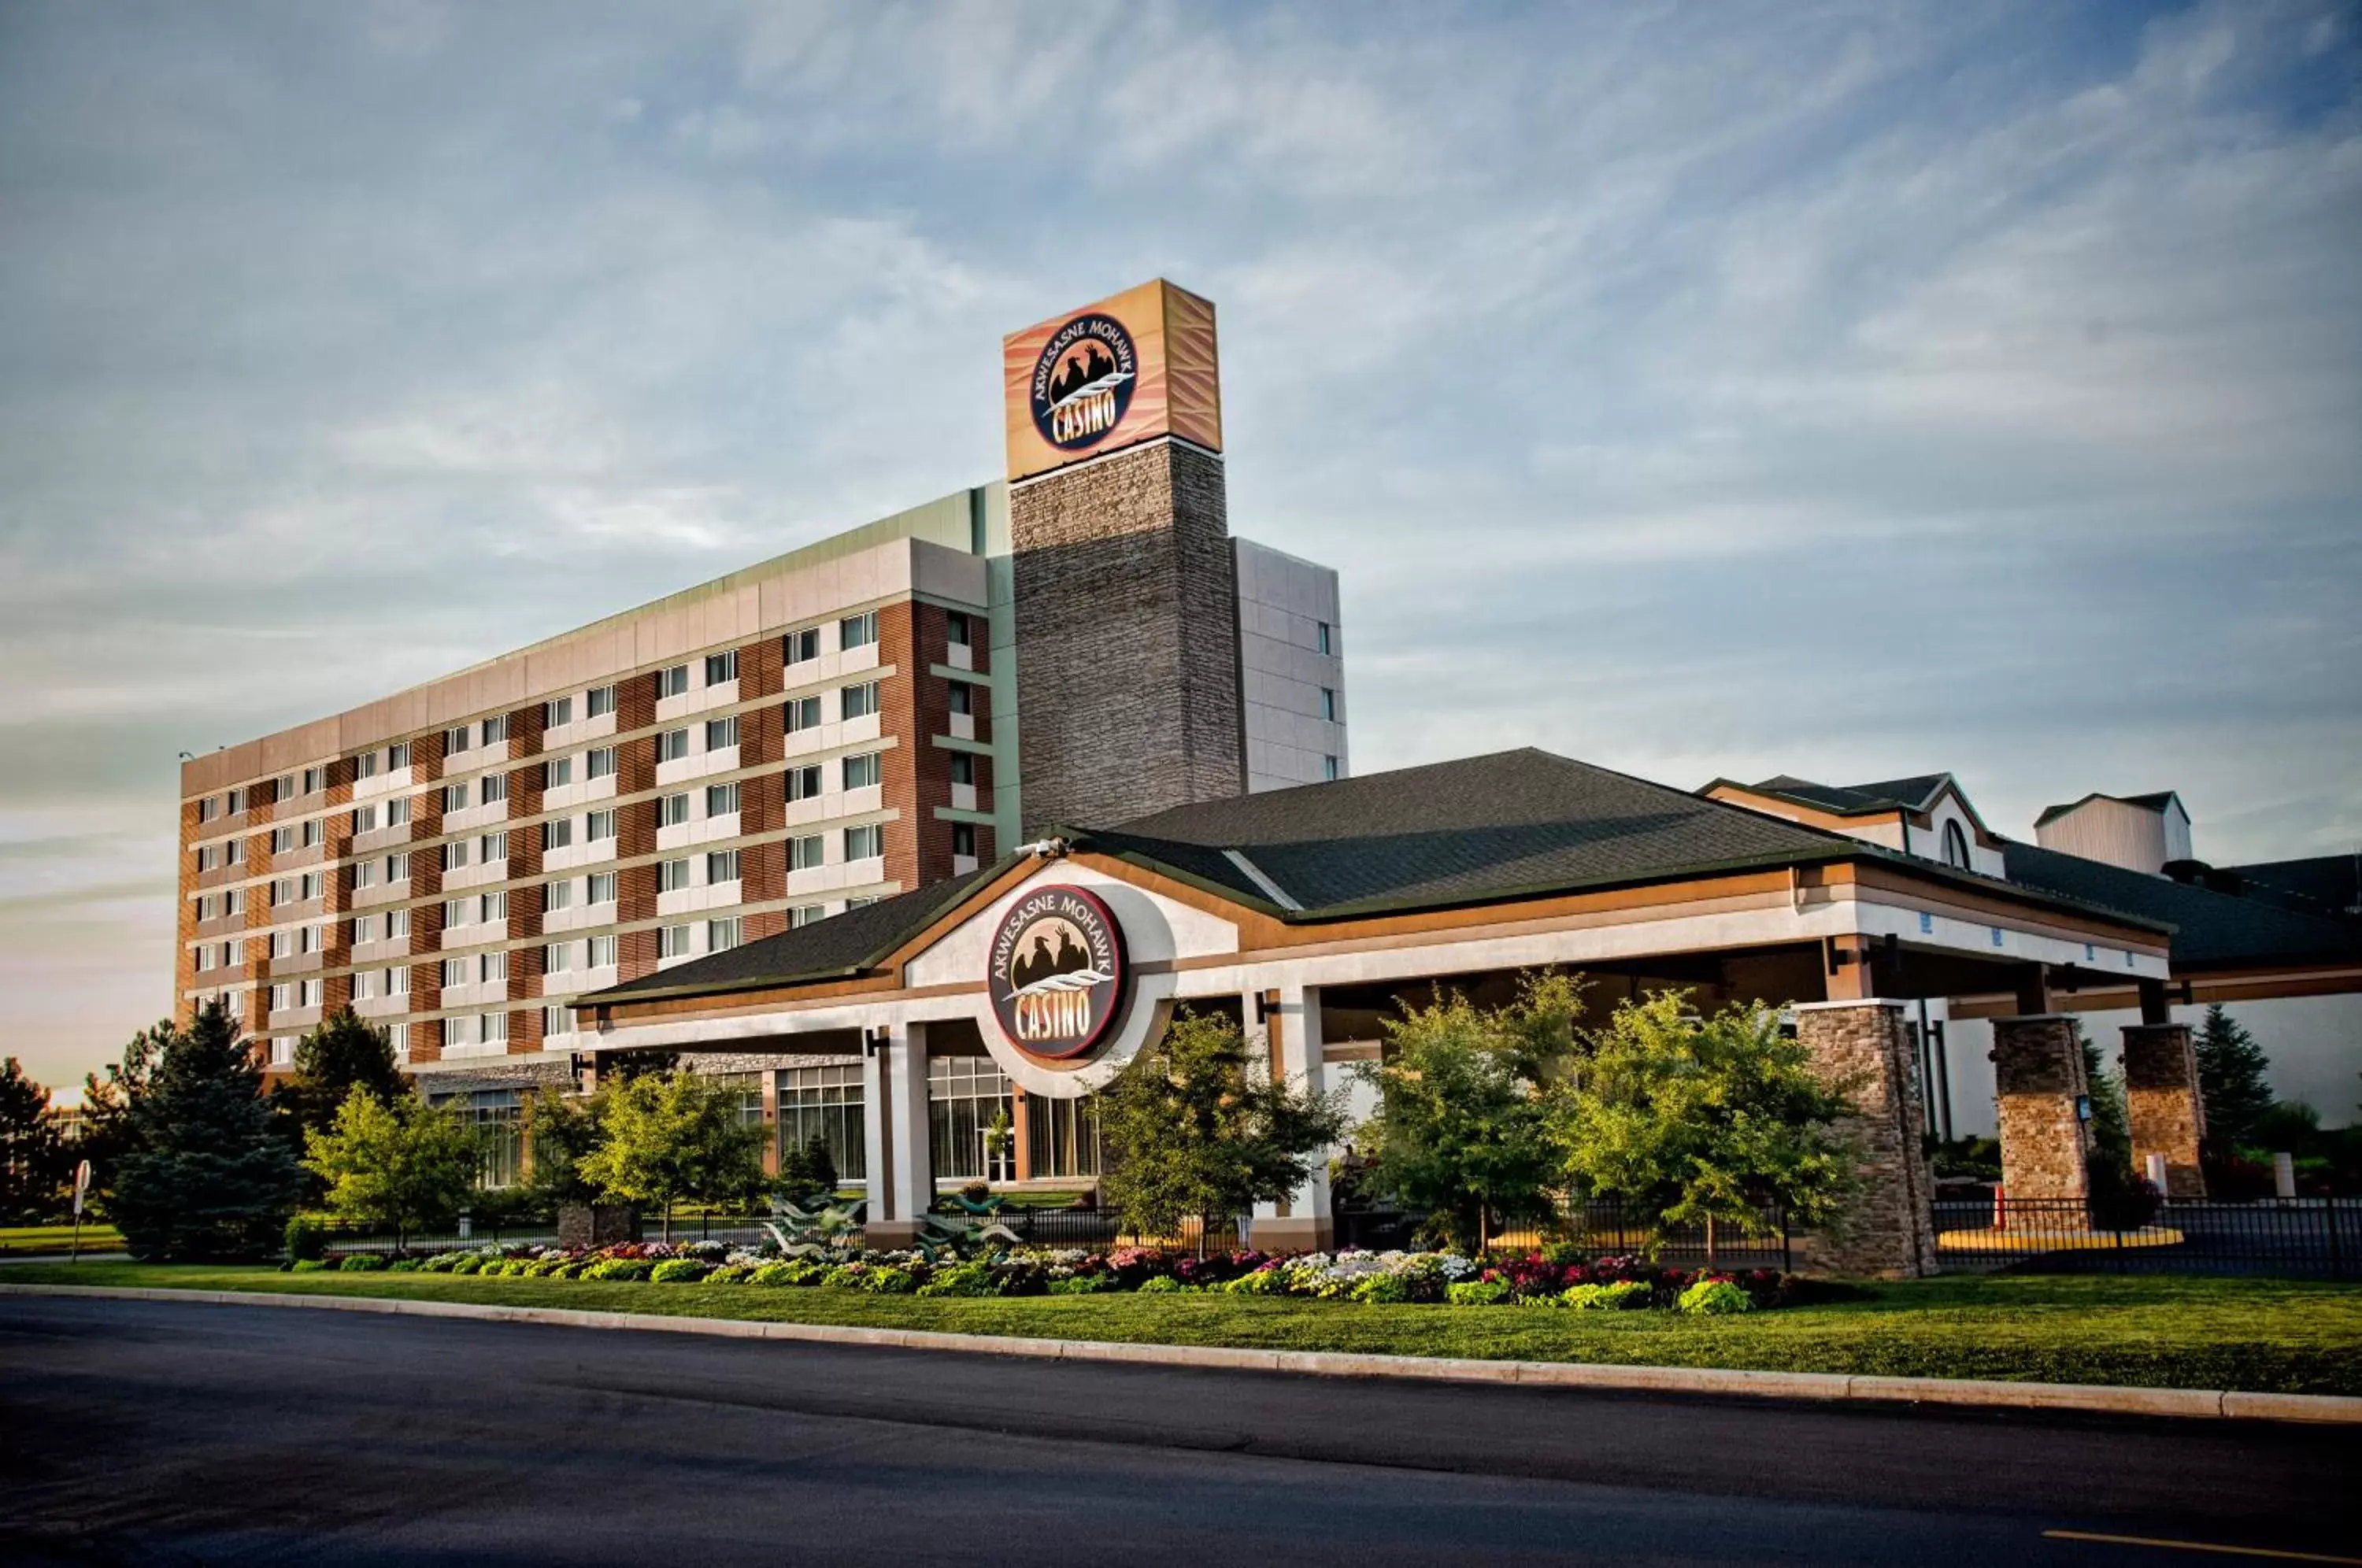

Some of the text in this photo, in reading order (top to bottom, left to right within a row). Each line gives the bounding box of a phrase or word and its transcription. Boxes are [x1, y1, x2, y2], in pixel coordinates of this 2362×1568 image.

[1035, 320, 1133, 400] AKWESASNE MOHAWK
[1053, 391, 1116, 442] CASINO
[994, 894, 1111, 982] AKWESASNE MOHAWK
[1015, 990, 1091, 1041] CASINO
